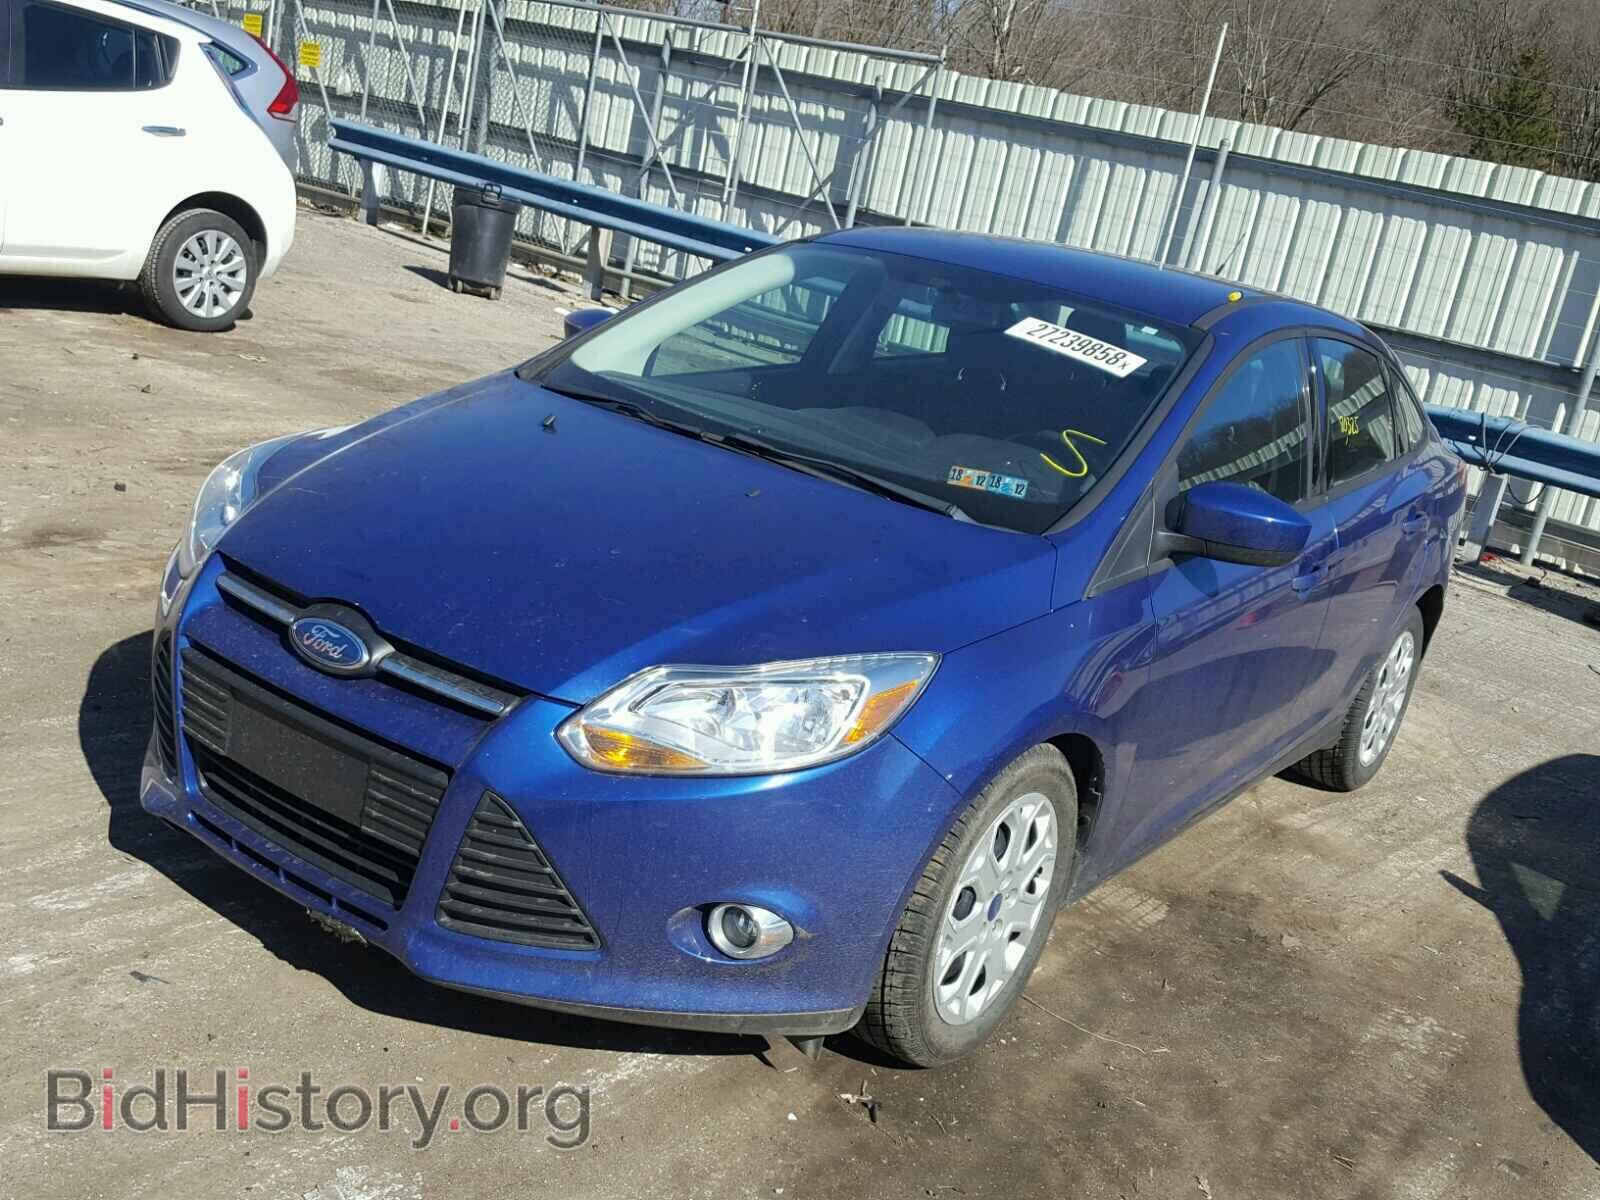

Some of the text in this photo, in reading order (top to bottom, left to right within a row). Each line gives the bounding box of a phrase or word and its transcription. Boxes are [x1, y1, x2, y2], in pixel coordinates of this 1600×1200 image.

[975, 475, 986, 487] 12
[1014, 483, 1025, 496] 12
[303, 624, 349, 659] Ford
